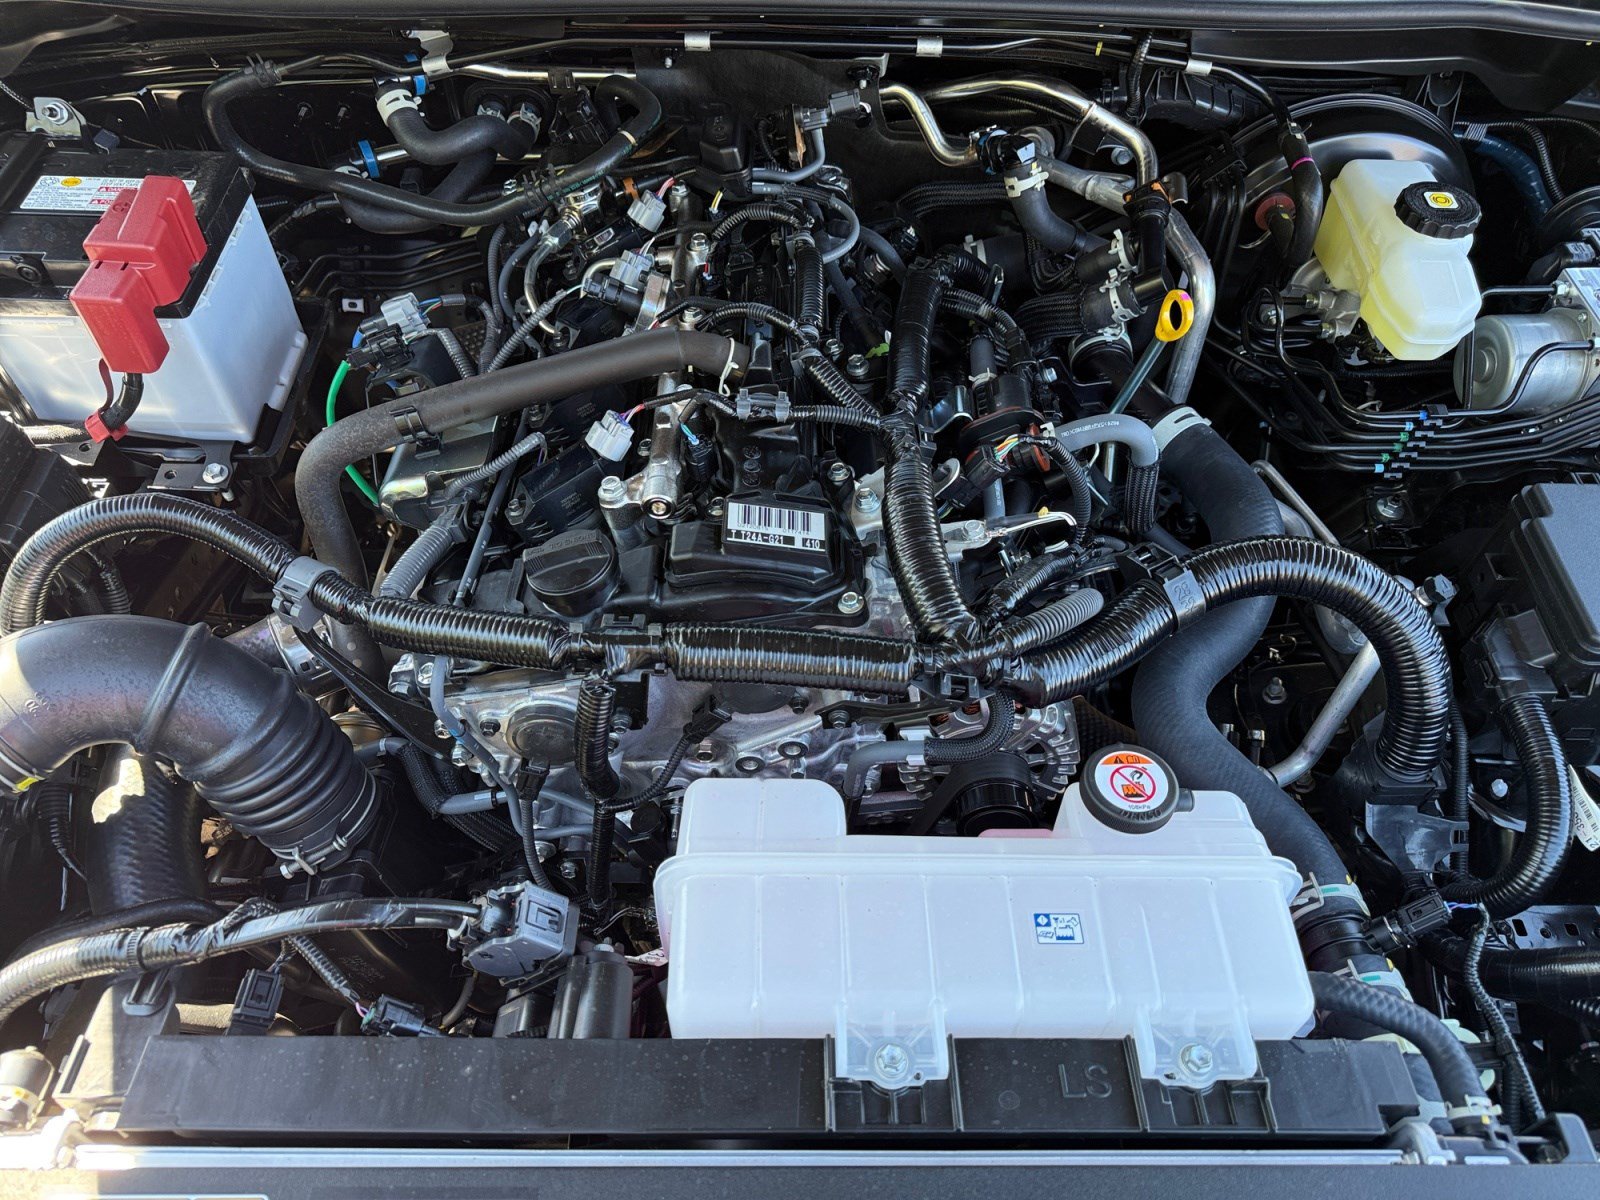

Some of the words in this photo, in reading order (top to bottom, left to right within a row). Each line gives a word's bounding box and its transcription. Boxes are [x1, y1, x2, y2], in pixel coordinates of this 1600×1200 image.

[731, 529, 737, 539] T
[741, 531, 784, 544] T24A-G21
[805, 539, 821, 549] 410
[1120, 808, 1163, 823] DENSO
[1058, 1063, 1112, 1098] LS
